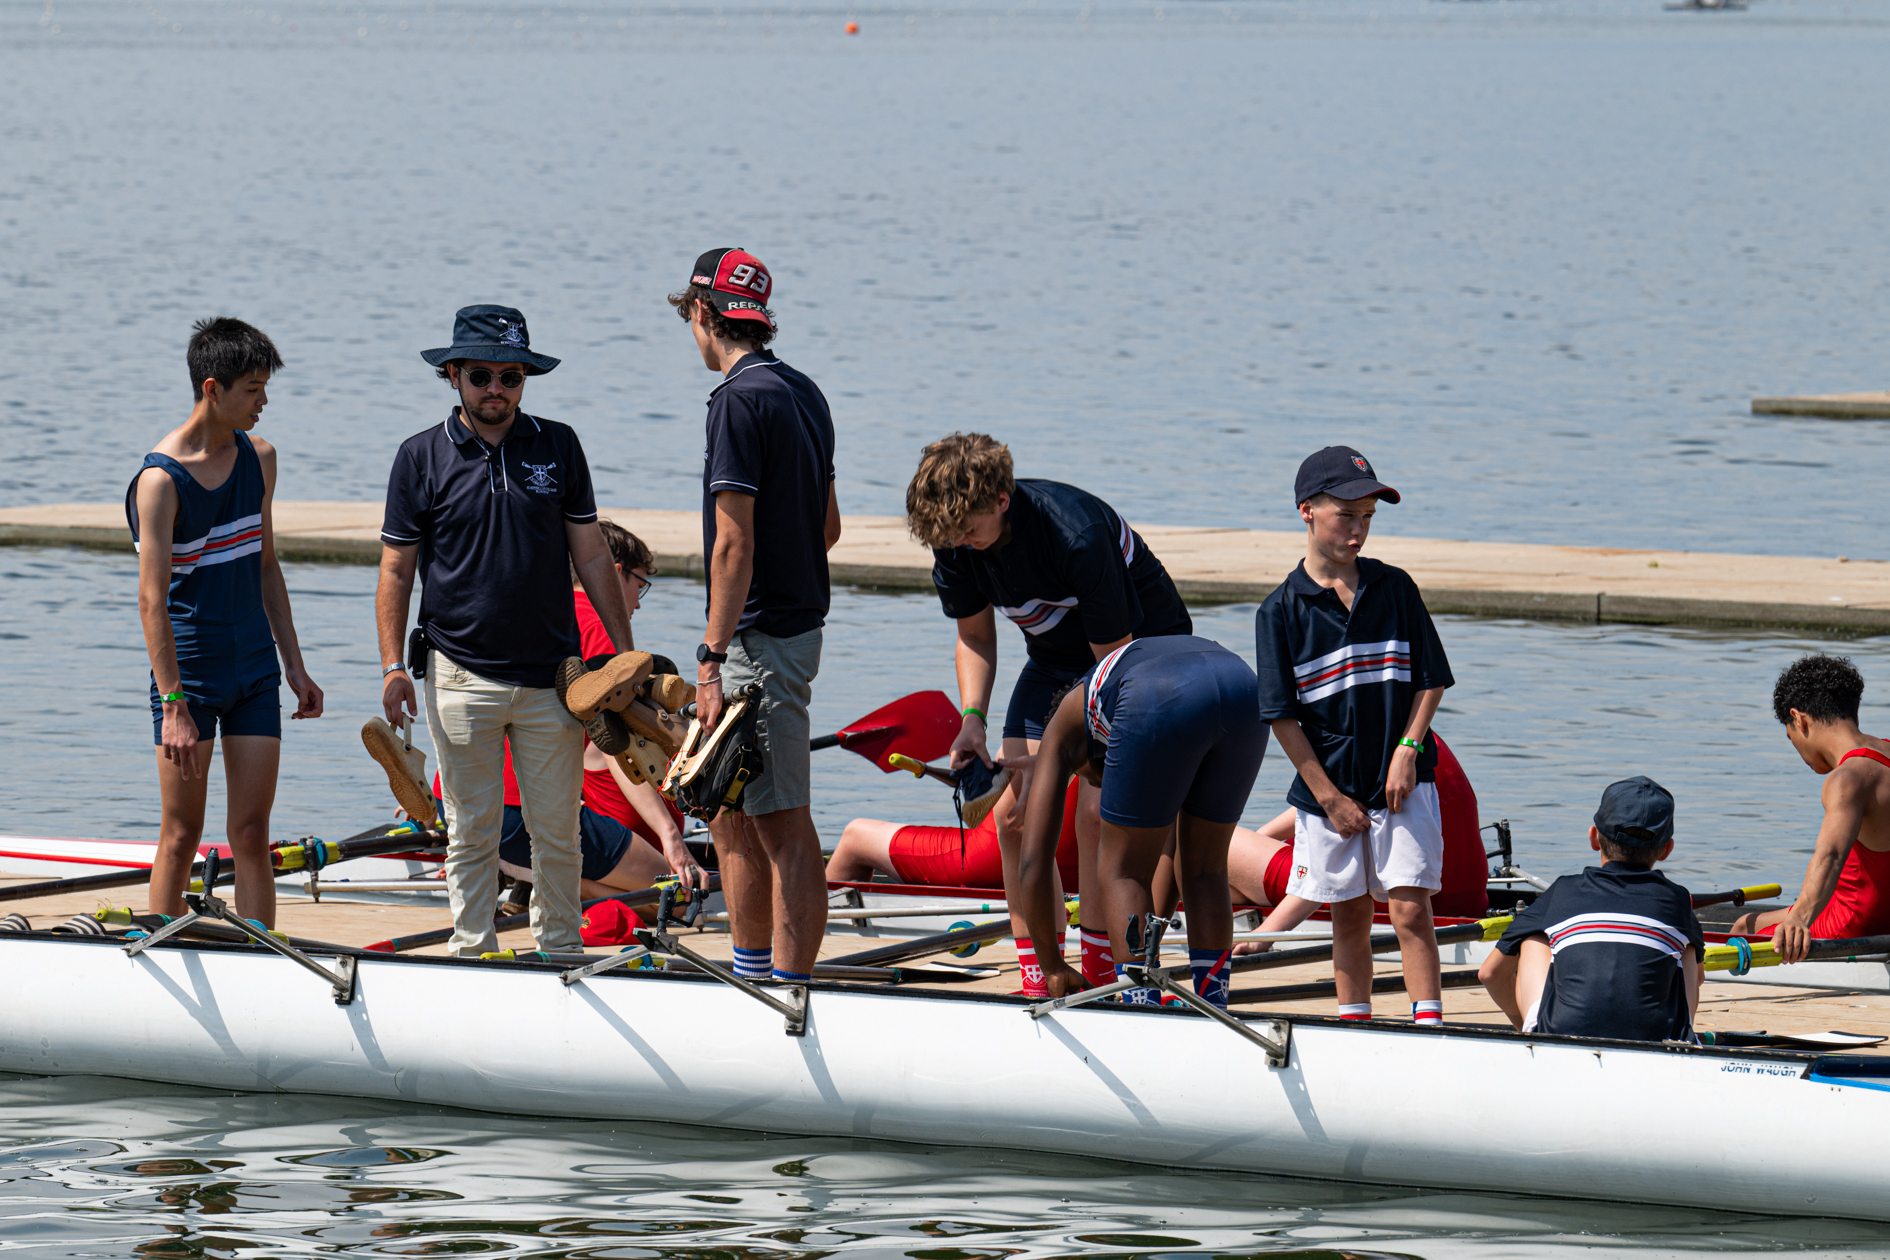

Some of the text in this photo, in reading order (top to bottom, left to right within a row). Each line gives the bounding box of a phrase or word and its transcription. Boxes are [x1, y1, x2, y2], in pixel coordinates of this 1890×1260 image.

[728, 264, 769, 295] 93
[1720, 1062, 1797, 1077] JOHN WAUGH
